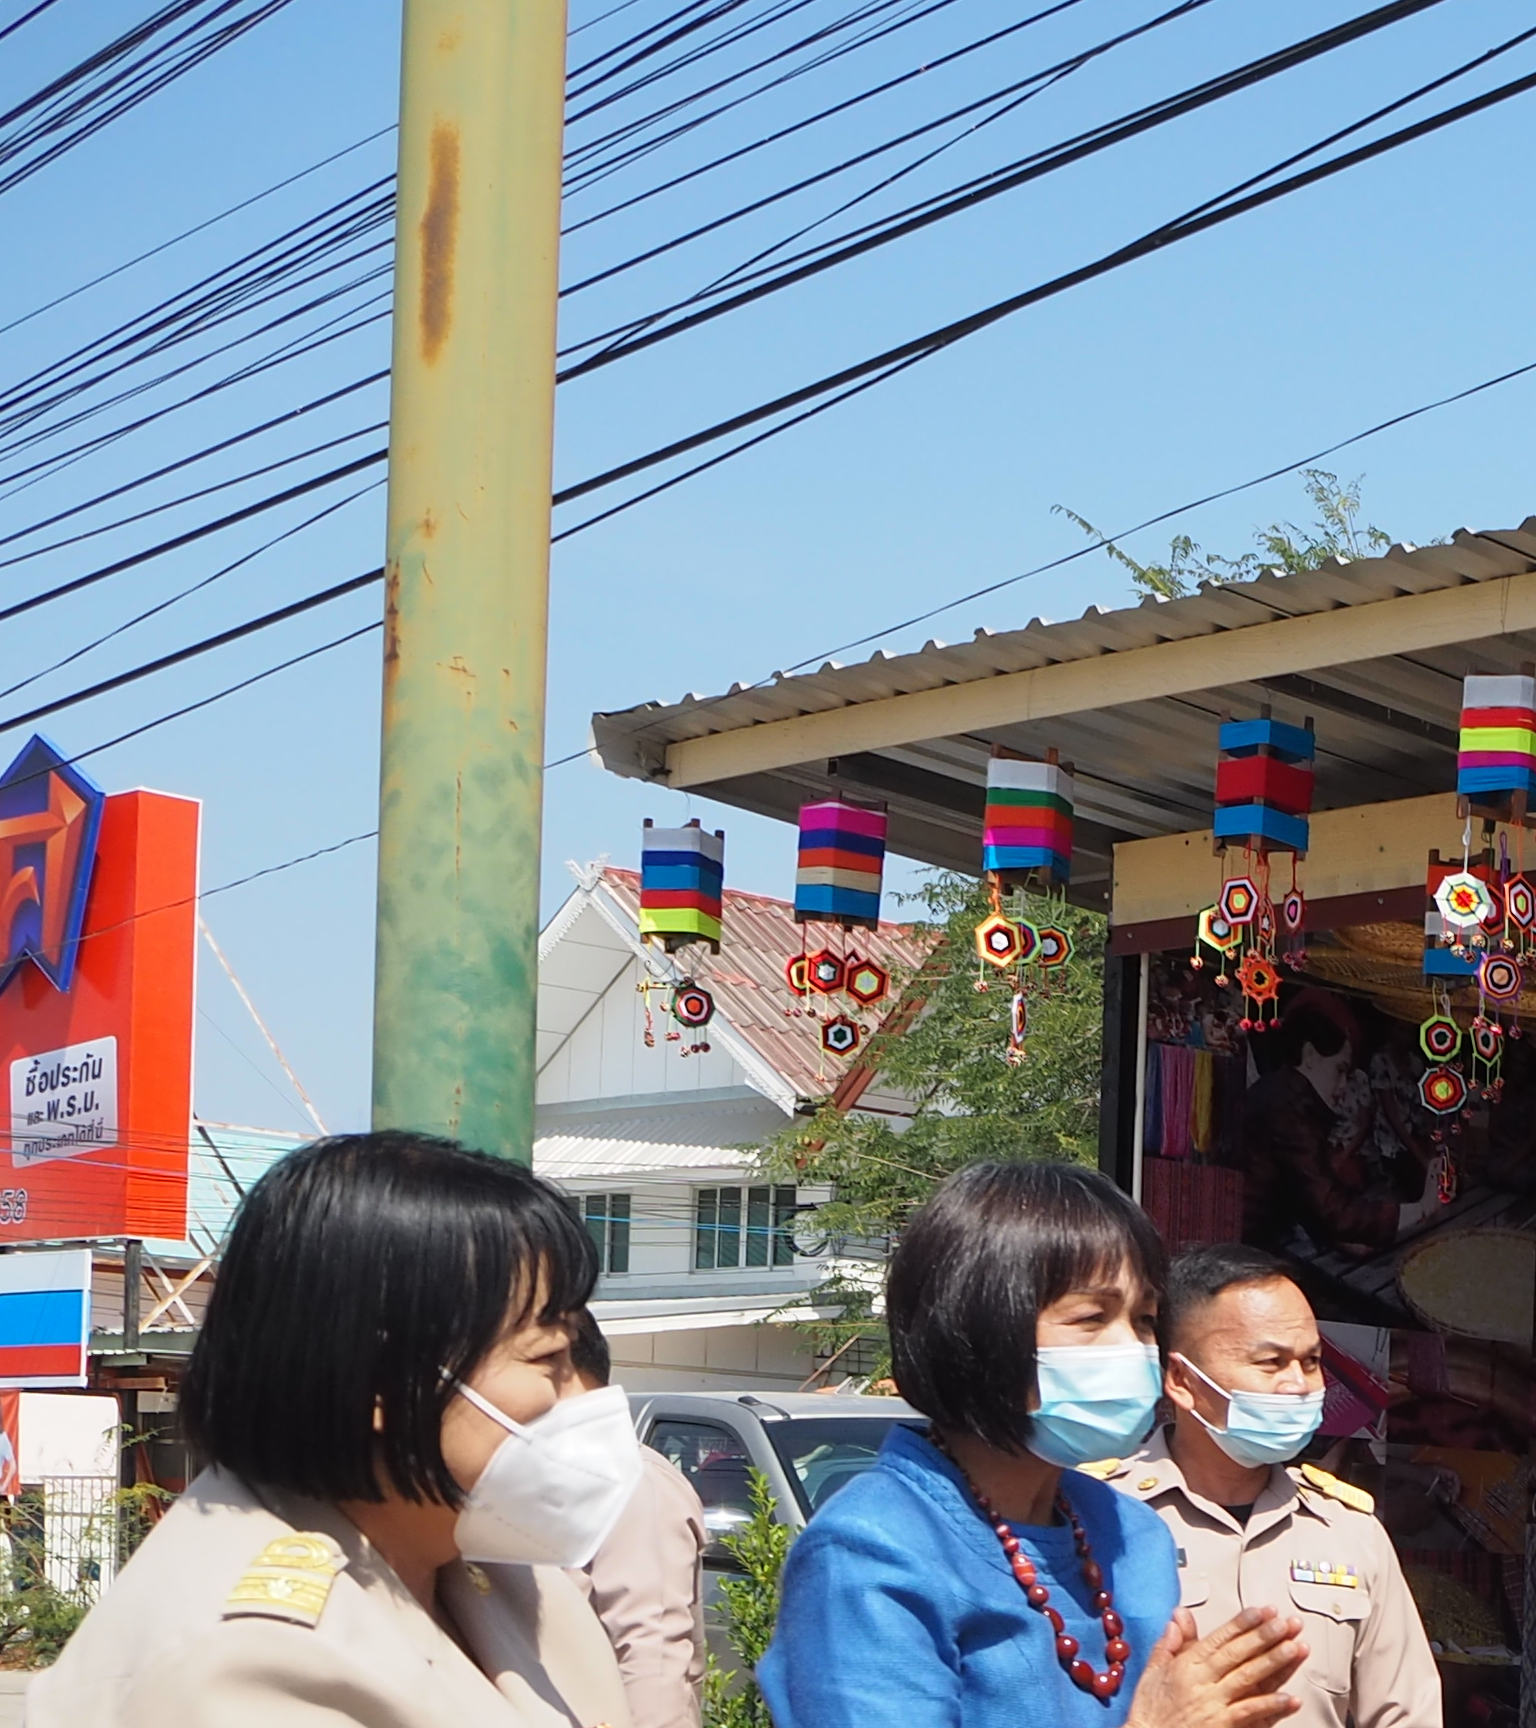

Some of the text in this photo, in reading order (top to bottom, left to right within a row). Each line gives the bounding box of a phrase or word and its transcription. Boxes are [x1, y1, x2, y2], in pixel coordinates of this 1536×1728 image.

[25, 1053, 103, 1097] ซื้อประกัน
[47, 1091, 100, 1121] พ.ร.บ.
